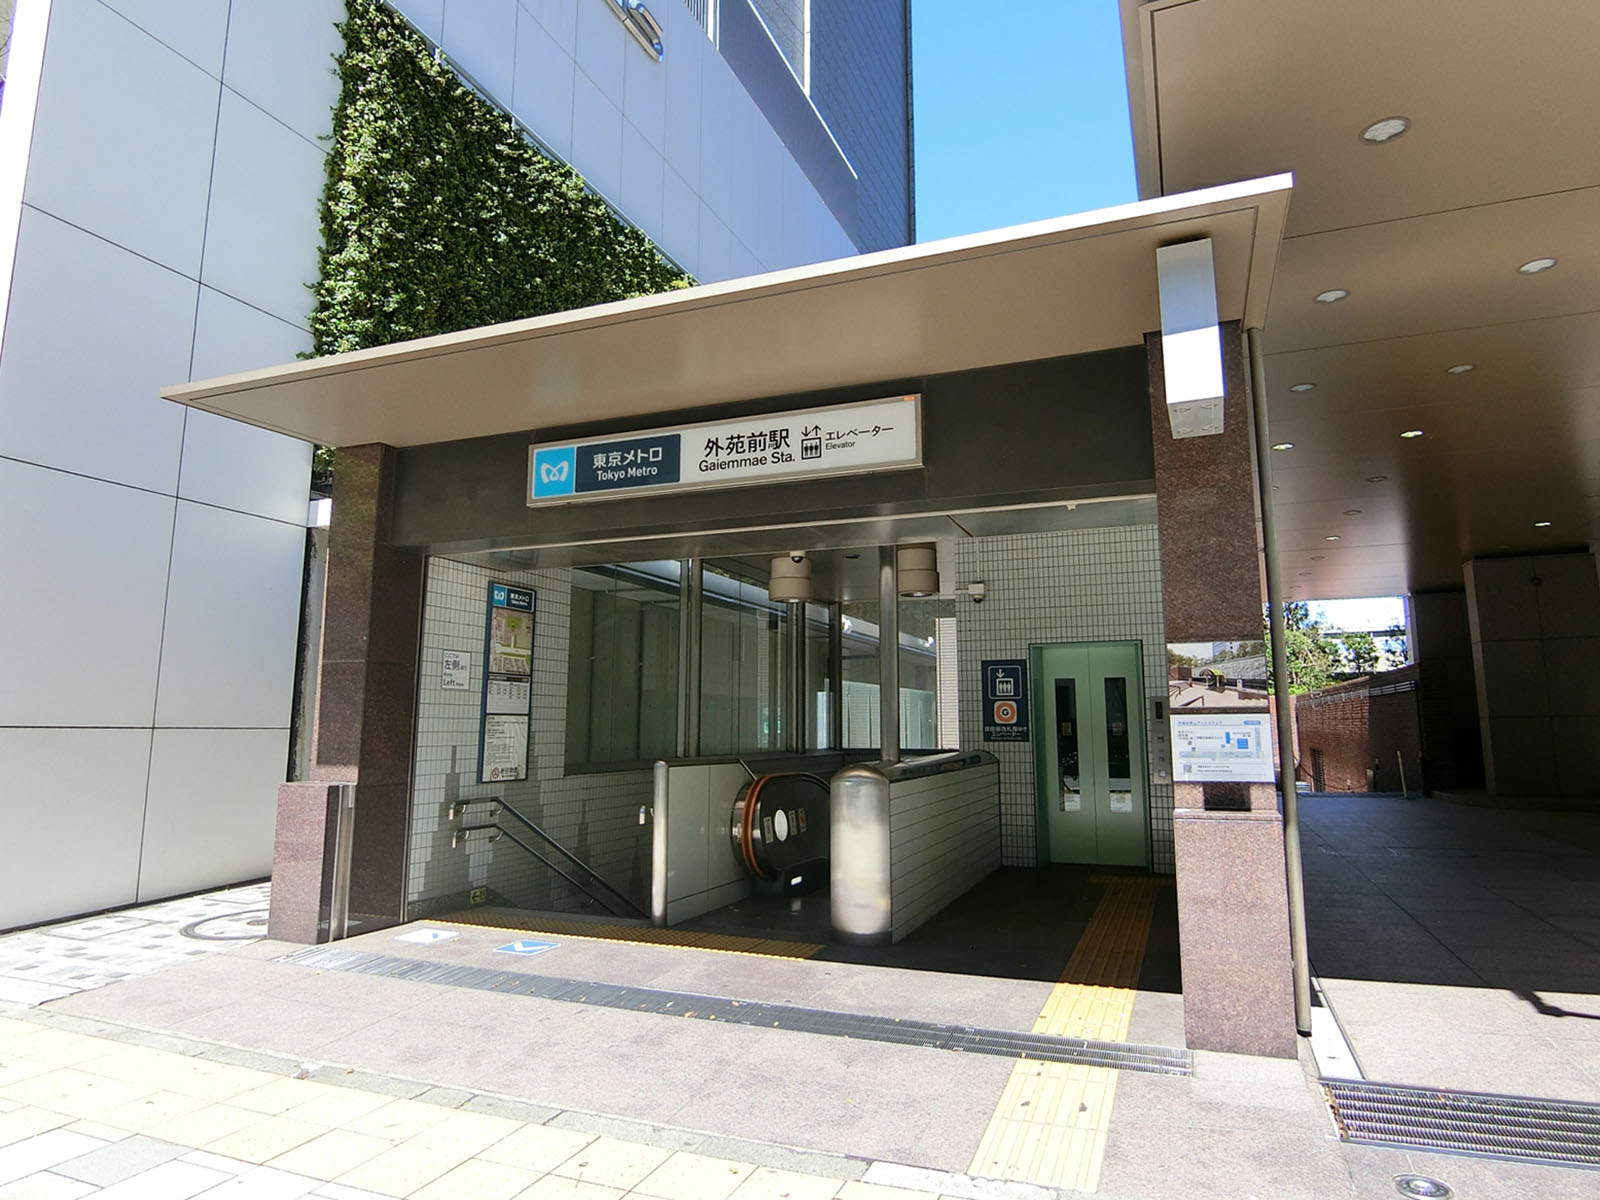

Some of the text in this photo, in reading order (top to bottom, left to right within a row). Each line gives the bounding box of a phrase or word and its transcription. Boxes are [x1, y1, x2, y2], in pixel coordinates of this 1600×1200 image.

[825, 425, 895, 441] エレベーター
[704, 428, 791, 458] 外苑前駅
[825, 440, 856, 450] Elevator
[592, 447, 663, 469] 東京メトロ
[698, 451, 796, 473] Gaiemmae Sta.
[596, 466, 658, 482] Tokyo Metro
